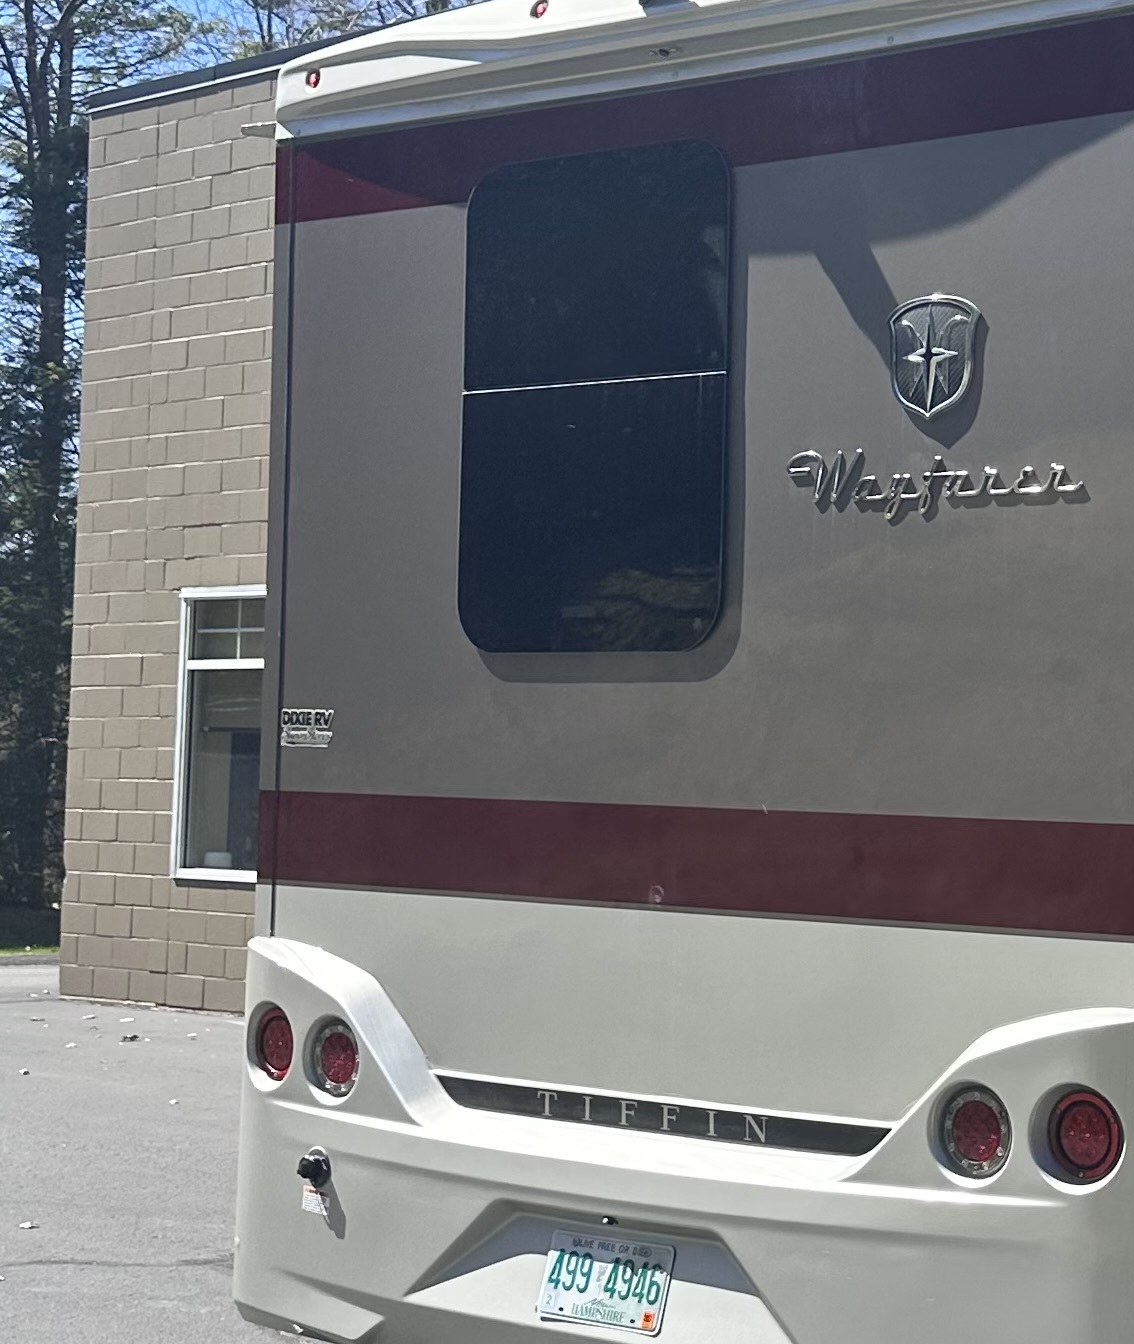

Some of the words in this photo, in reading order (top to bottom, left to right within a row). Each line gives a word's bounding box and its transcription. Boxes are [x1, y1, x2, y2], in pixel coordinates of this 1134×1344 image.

[787, 448, 1083, 519] Wayfarer
[282, 711, 312, 726] DIXIE
[314, 711, 333, 726] RV
[536, 1090, 768, 1143] TIFFIN
[597, 1241, 616, 1253] FREE
[618, 1244, 630, 1254] OR
[547, 1248, 594, 1294] 499
[603, 1256, 662, 1306] 4946
[570, 1302, 627, 1324] HAMPSHIRE
